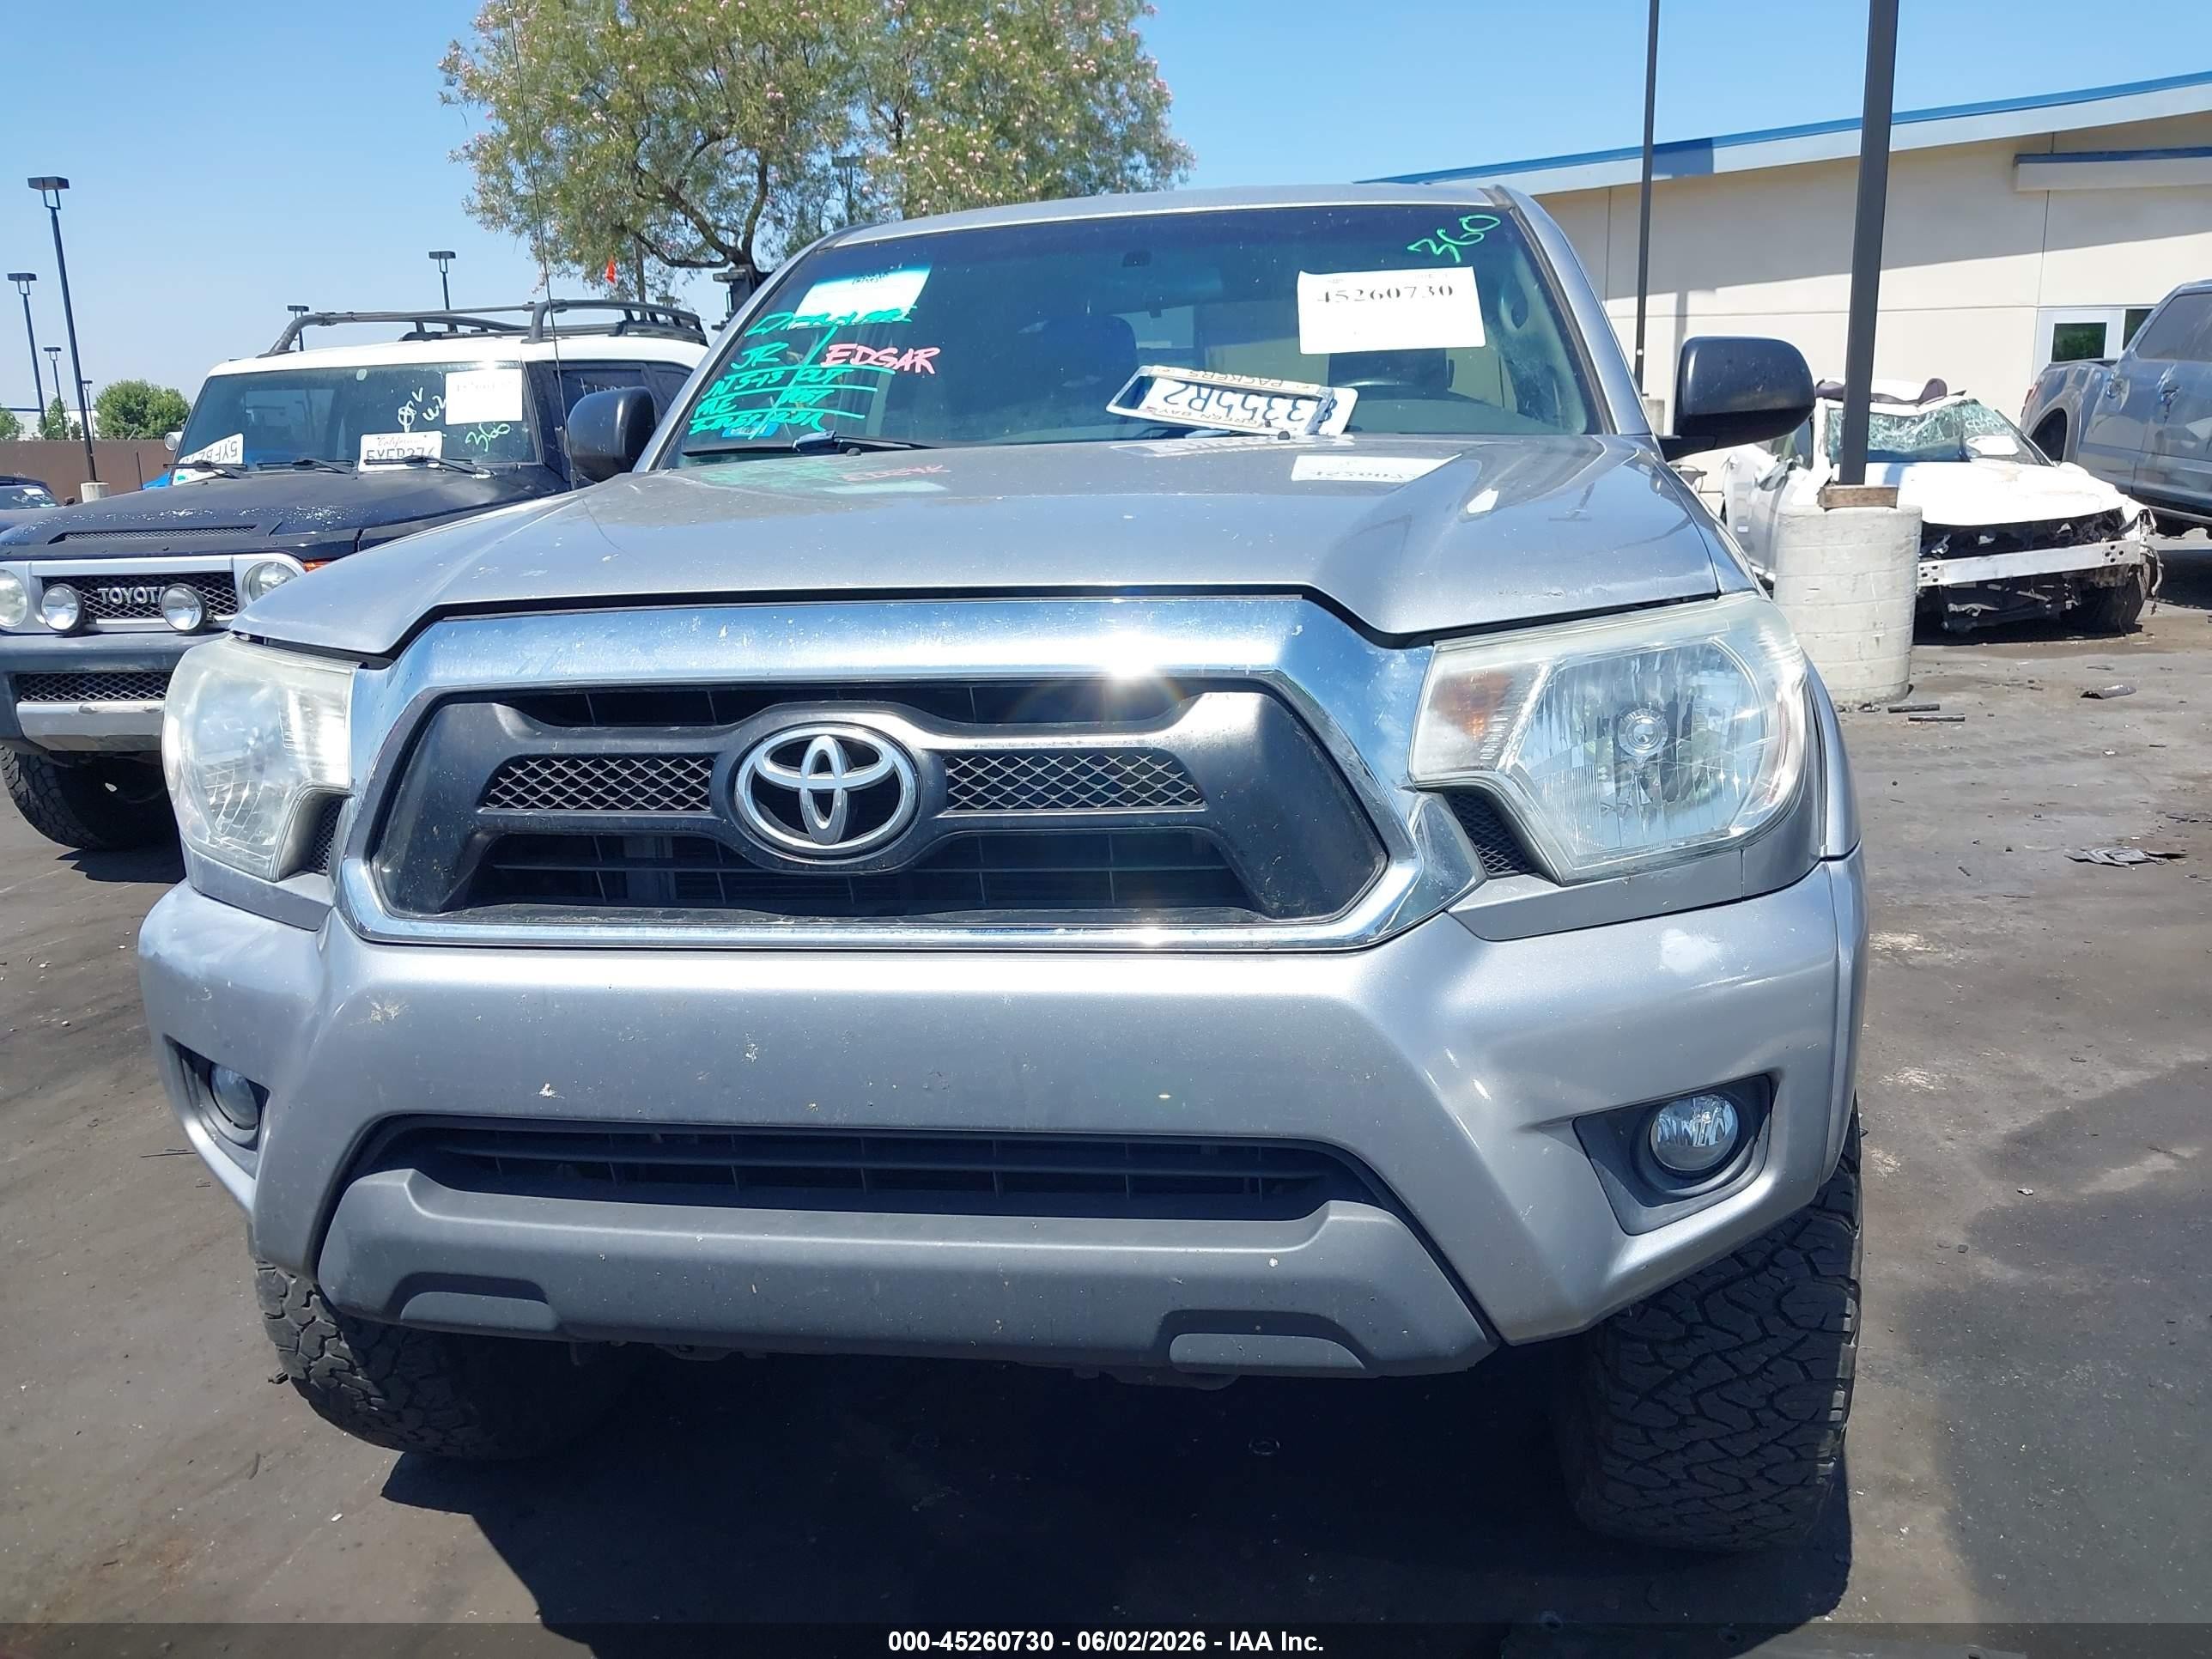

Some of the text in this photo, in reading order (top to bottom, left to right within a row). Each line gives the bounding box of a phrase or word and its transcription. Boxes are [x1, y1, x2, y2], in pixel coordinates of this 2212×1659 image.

[1407, 215, 1501, 263] 360
[1188, 371, 1284, 387] PACKERS
[465, 422, 511, 453] 360
